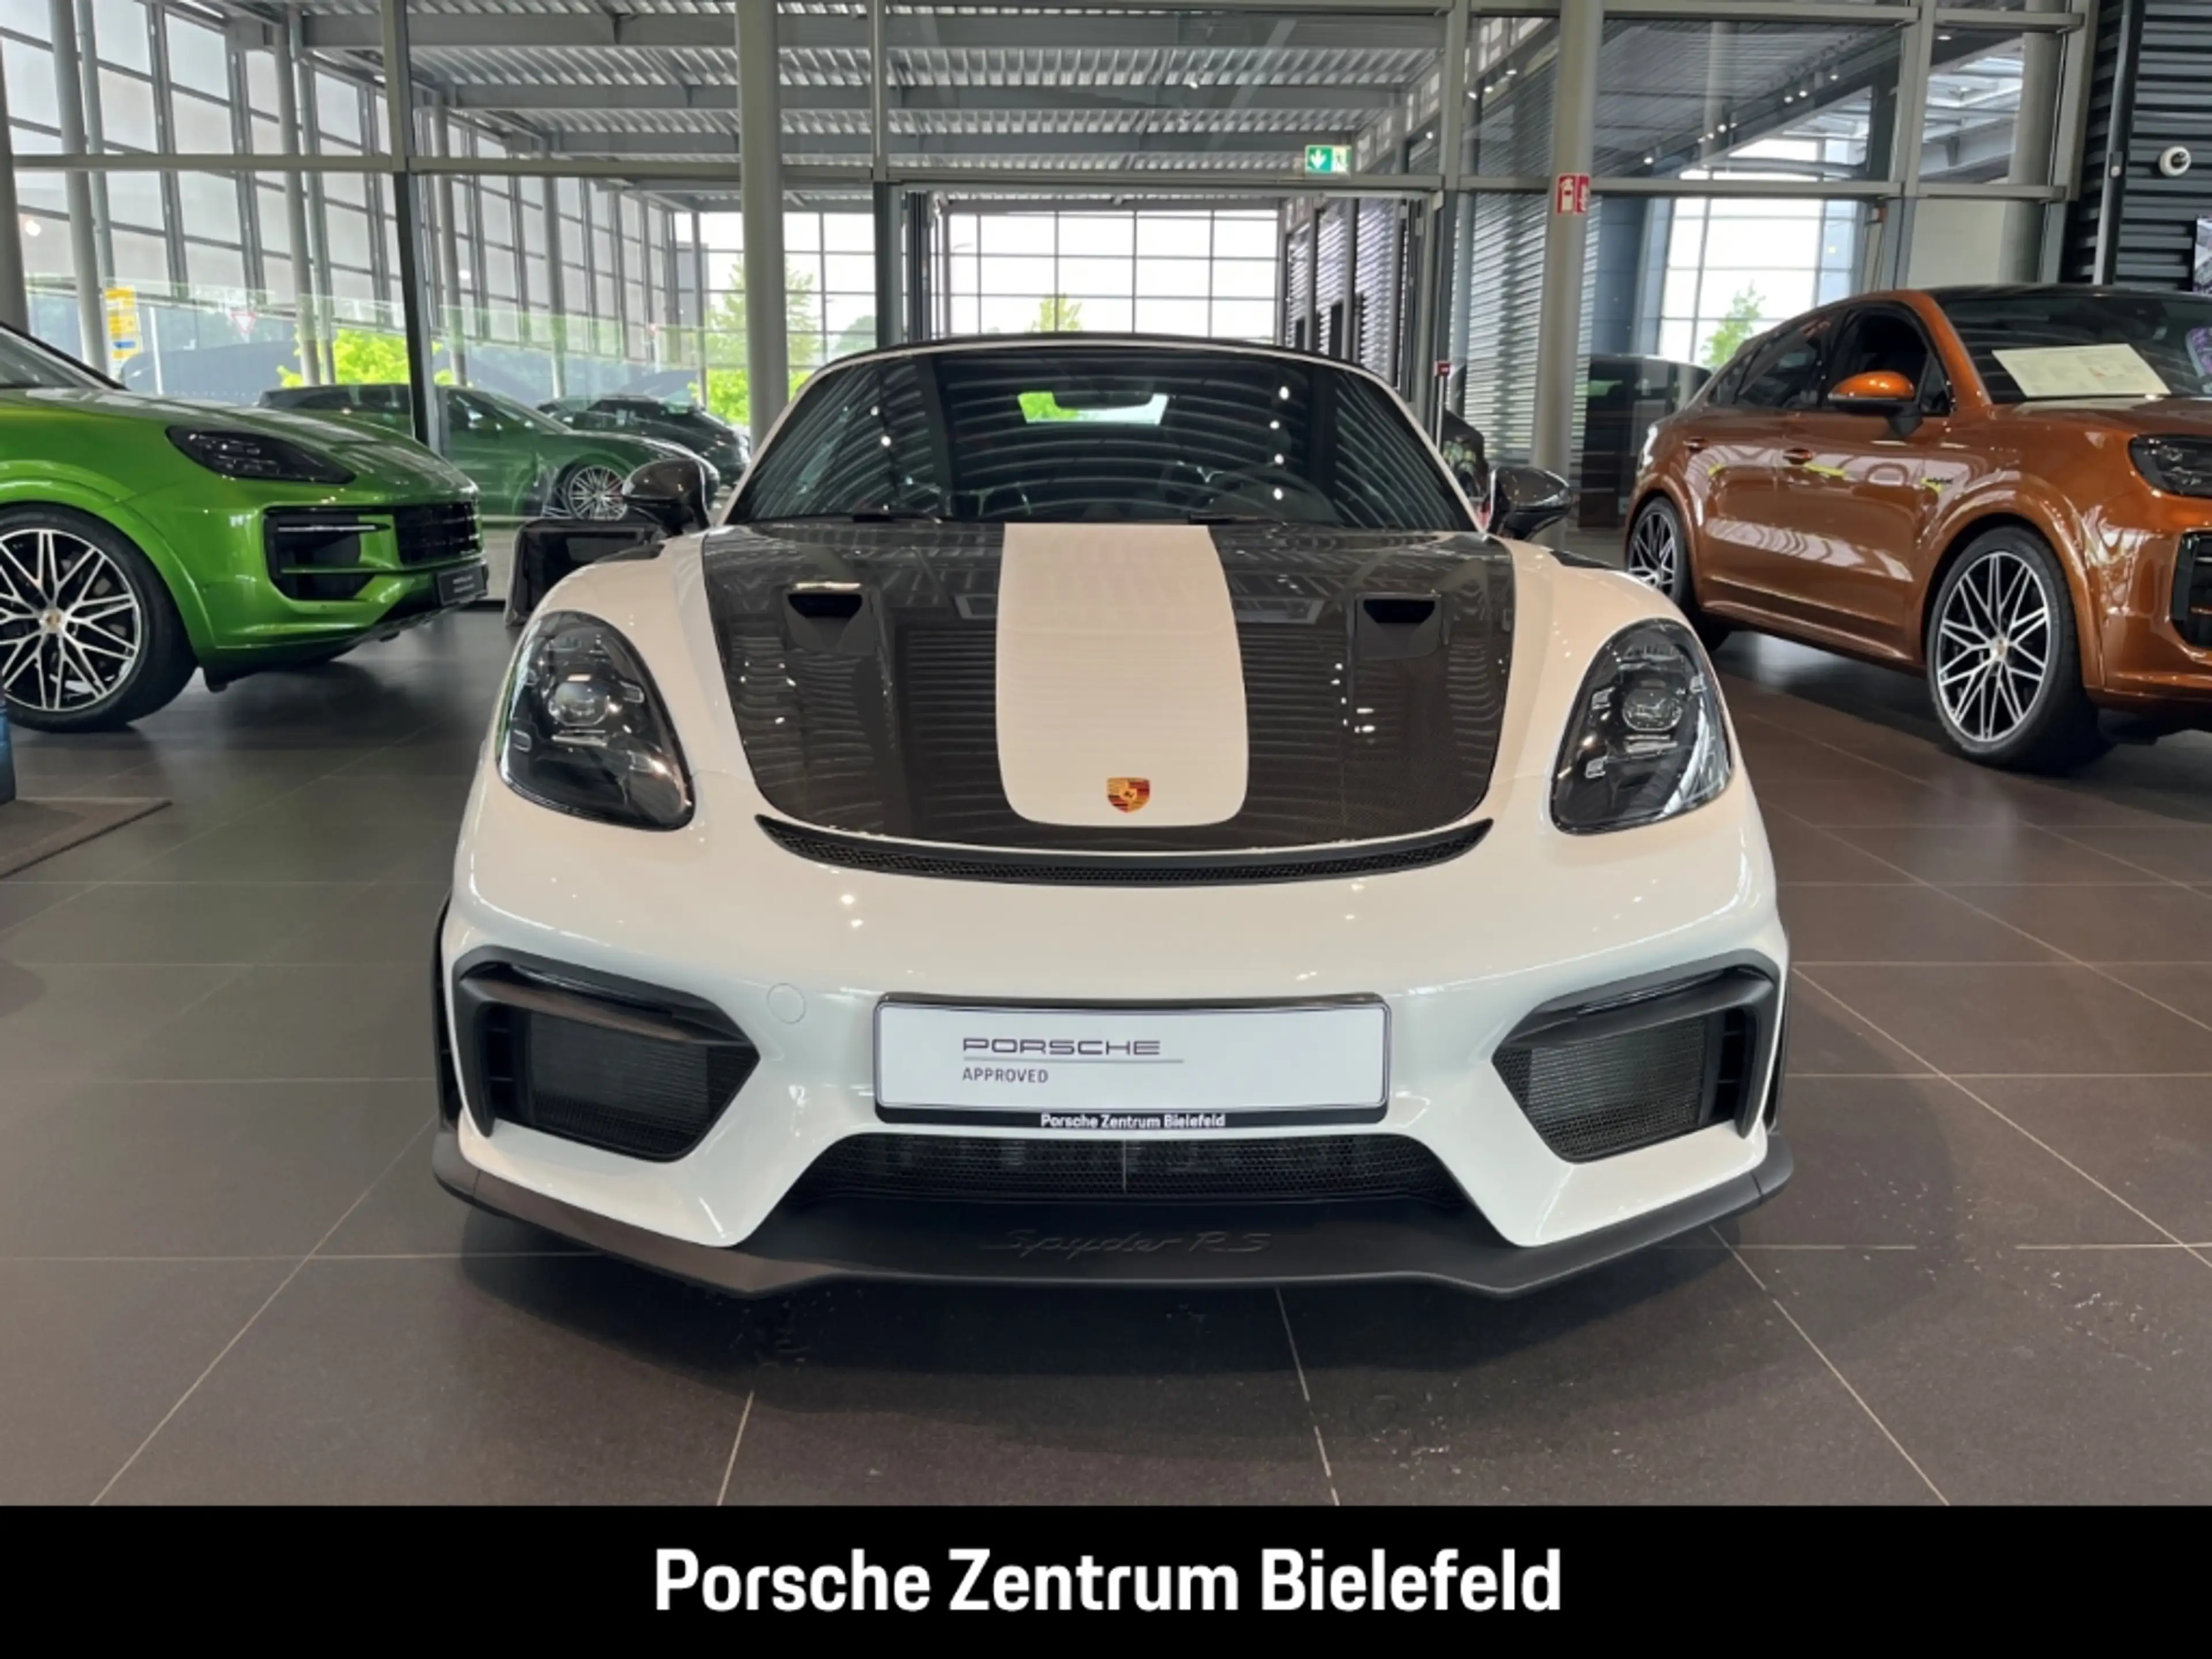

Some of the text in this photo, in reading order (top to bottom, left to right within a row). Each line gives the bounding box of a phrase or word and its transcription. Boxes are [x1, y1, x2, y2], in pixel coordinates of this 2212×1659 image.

[963, 1037, 1161, 1055] PORSCHE
[963, 1067, 1049, 1084] APPROVED
[1040, 1113, 1226, 1128] Porsche Zentrum Bielefeld
[979, 1229, 1272, 1260] Spyder RS
